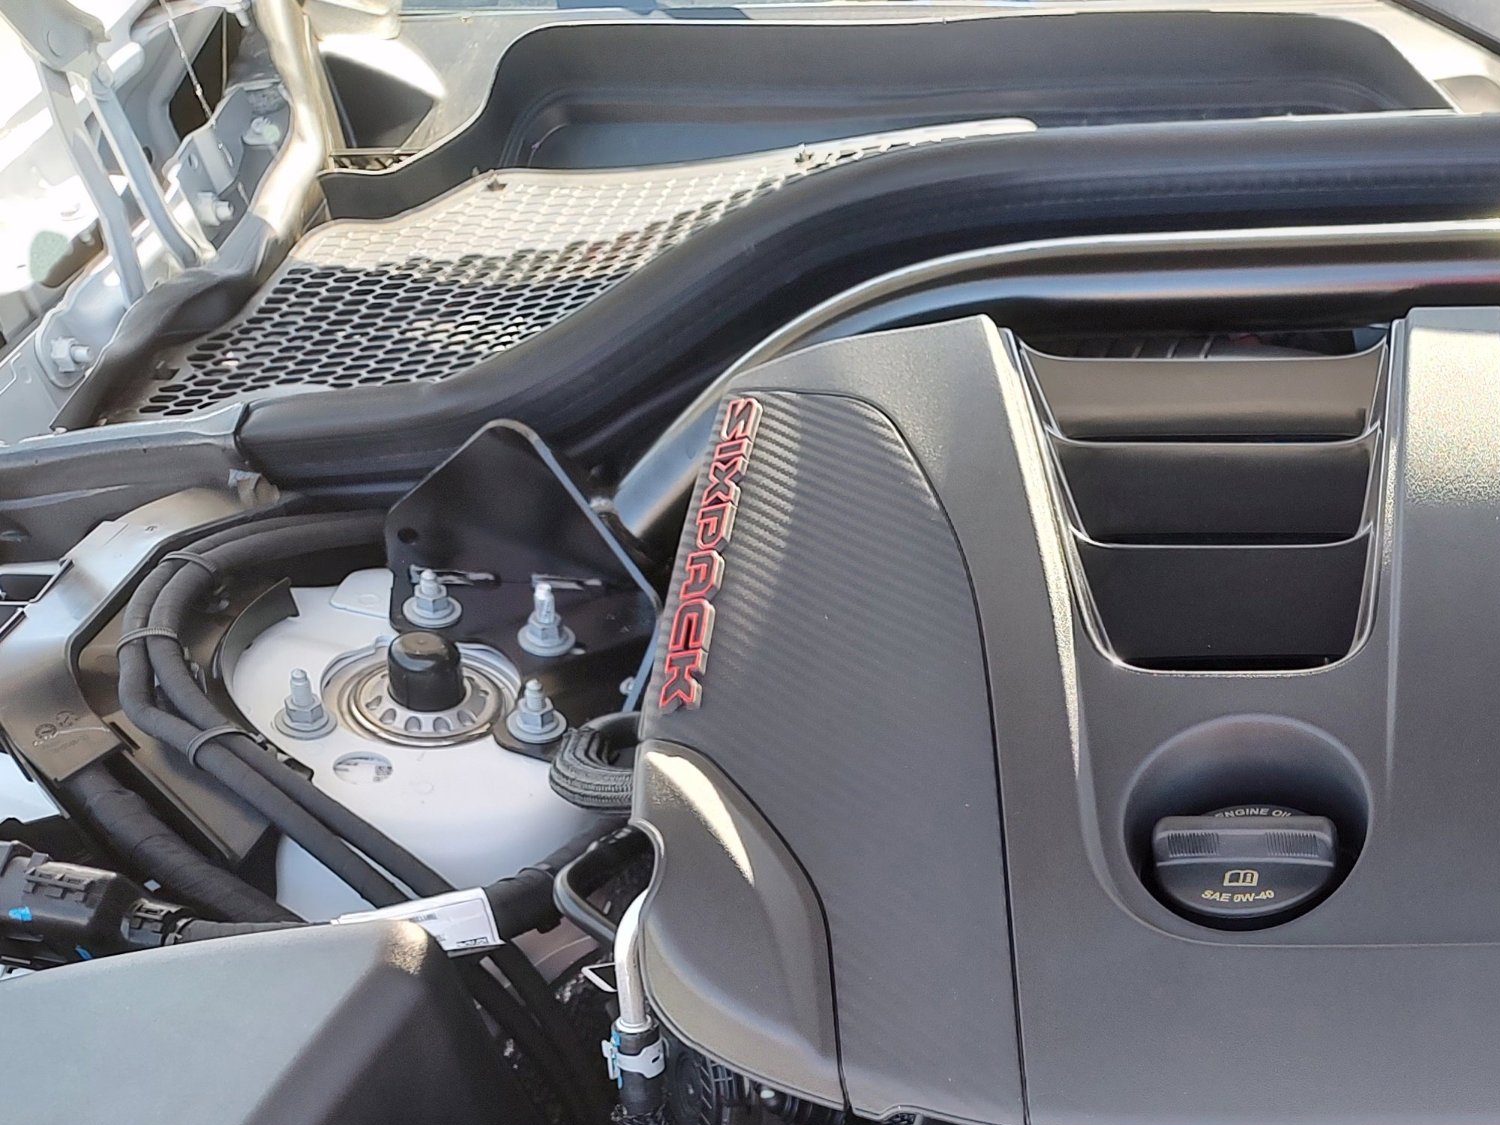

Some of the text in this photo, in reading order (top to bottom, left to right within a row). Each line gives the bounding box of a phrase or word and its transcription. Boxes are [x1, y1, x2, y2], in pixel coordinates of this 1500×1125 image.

[659, 397, 763, 710] SIXPACK
[1201, 889, 1275, 903] SAE 0W-40
